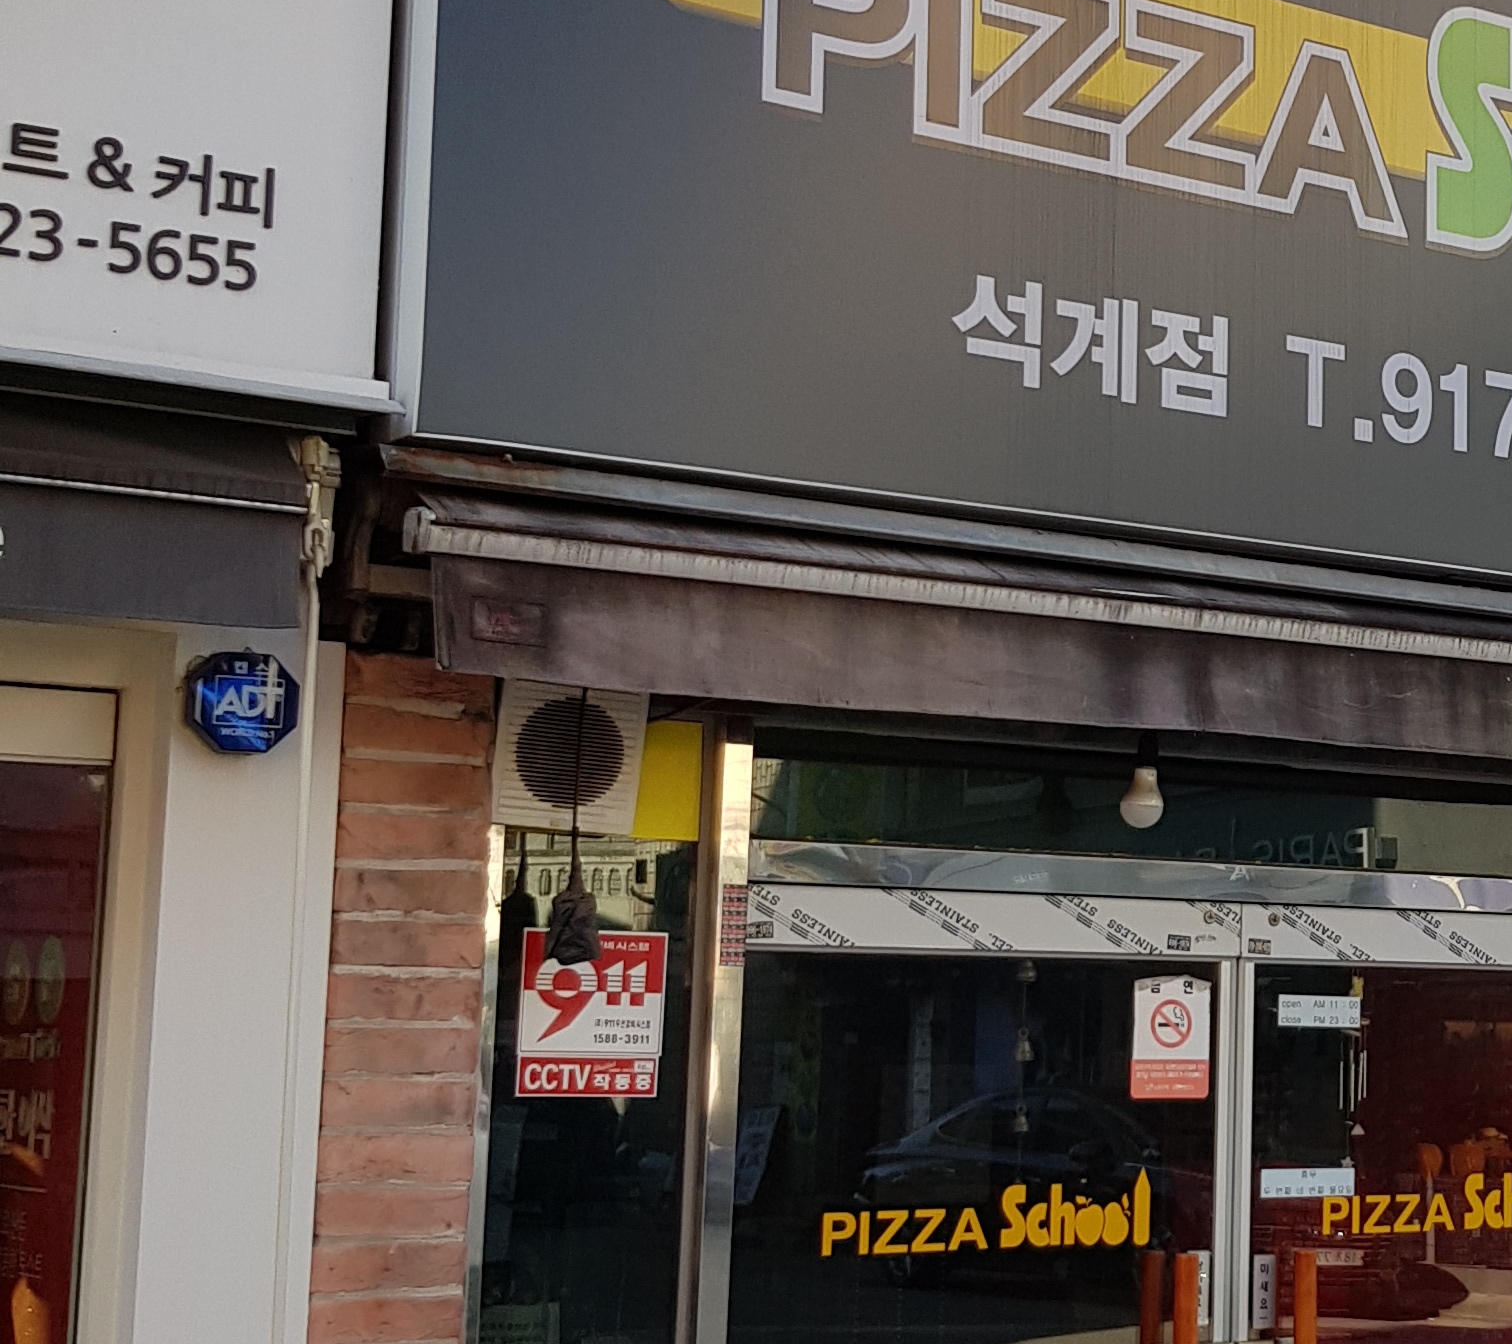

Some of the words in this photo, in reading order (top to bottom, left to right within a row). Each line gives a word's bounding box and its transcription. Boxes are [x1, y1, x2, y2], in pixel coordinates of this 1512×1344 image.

[953, 273, 1231, 418] 석계점
[215, 684, 284, 719] ADT
[535, 958, 647, 1044] 911
[593, 1033, 651, 1044] 1588-3911
[524, 1062, 592, 1091] CCTV
[821, 1207, 988, 1256] PIZZA
[1000, 1167, 1151, 1249] School
[1321, 1193, 1455, 1236] PIZZA
